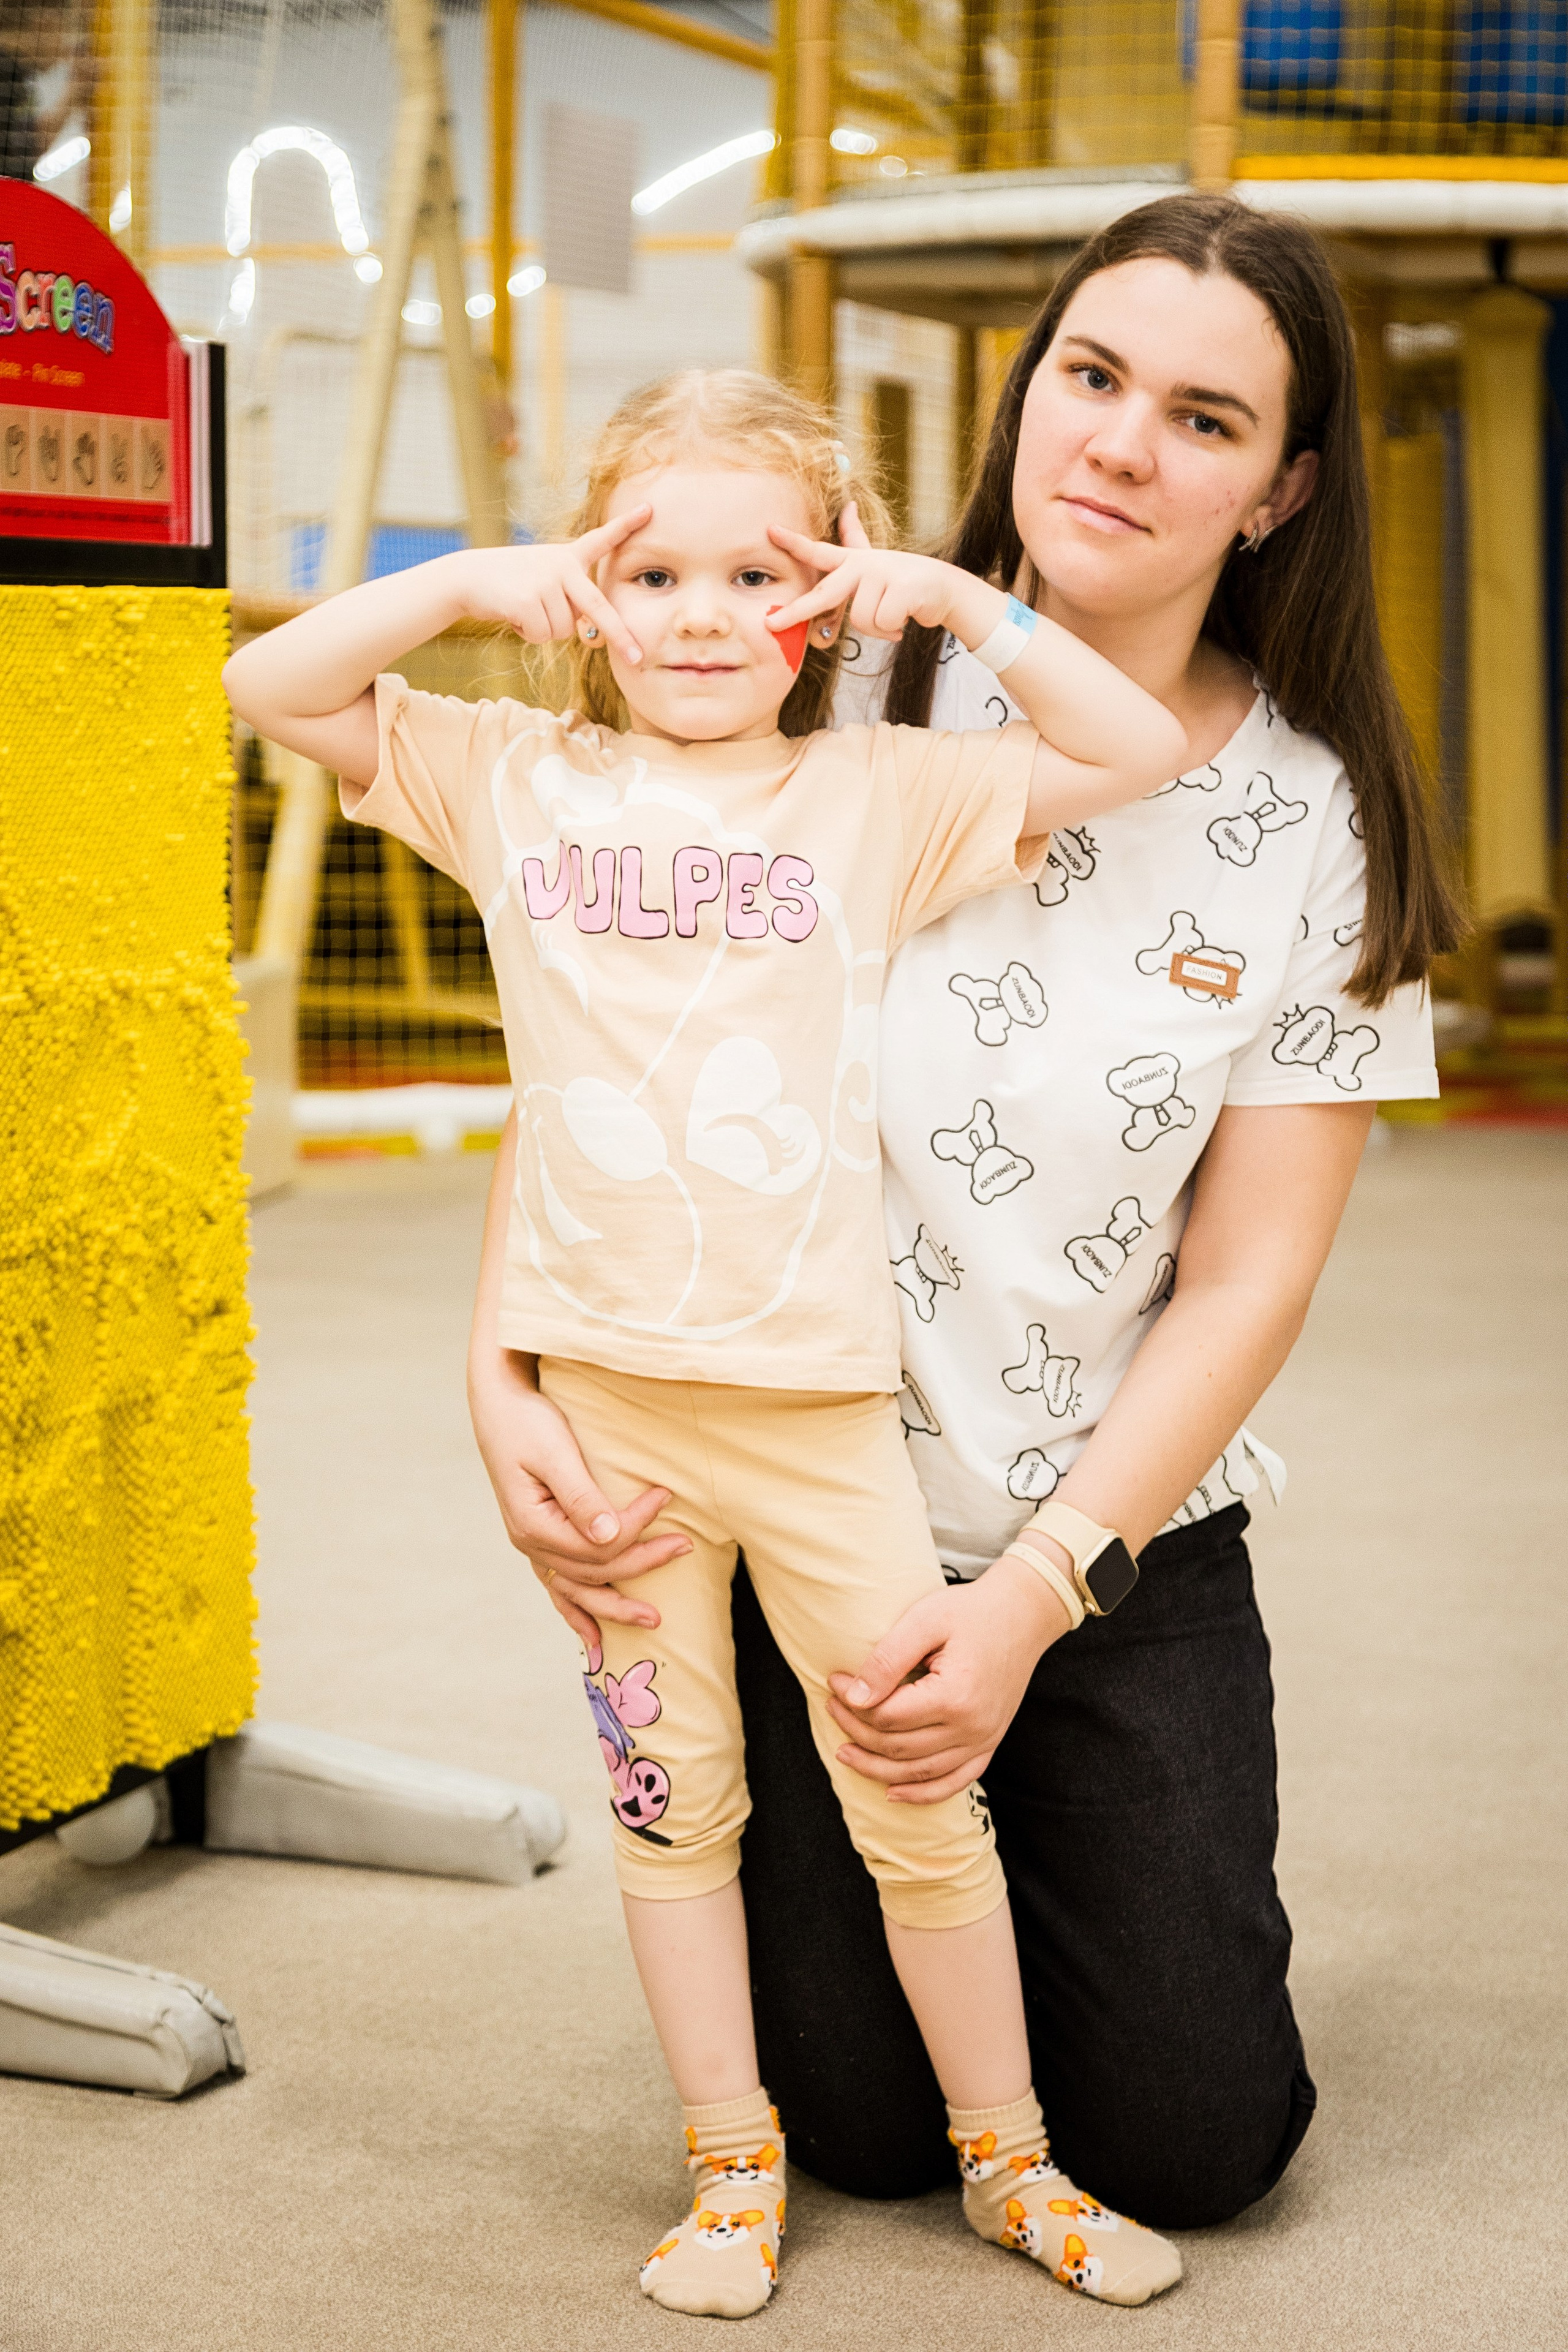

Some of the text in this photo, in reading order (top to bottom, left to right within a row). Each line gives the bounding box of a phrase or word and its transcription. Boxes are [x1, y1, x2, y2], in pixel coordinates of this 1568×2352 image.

[522, 839, 818, 943] VULPES
[1186, 965, 1223, 981] FASHION
[1011, 976, 1036, 1018] ZUNBAODI
[1291, 1019, 1325, 1055] ZUNBAODI
[979, 1161, 1018, 1189] ZUNBAODI
